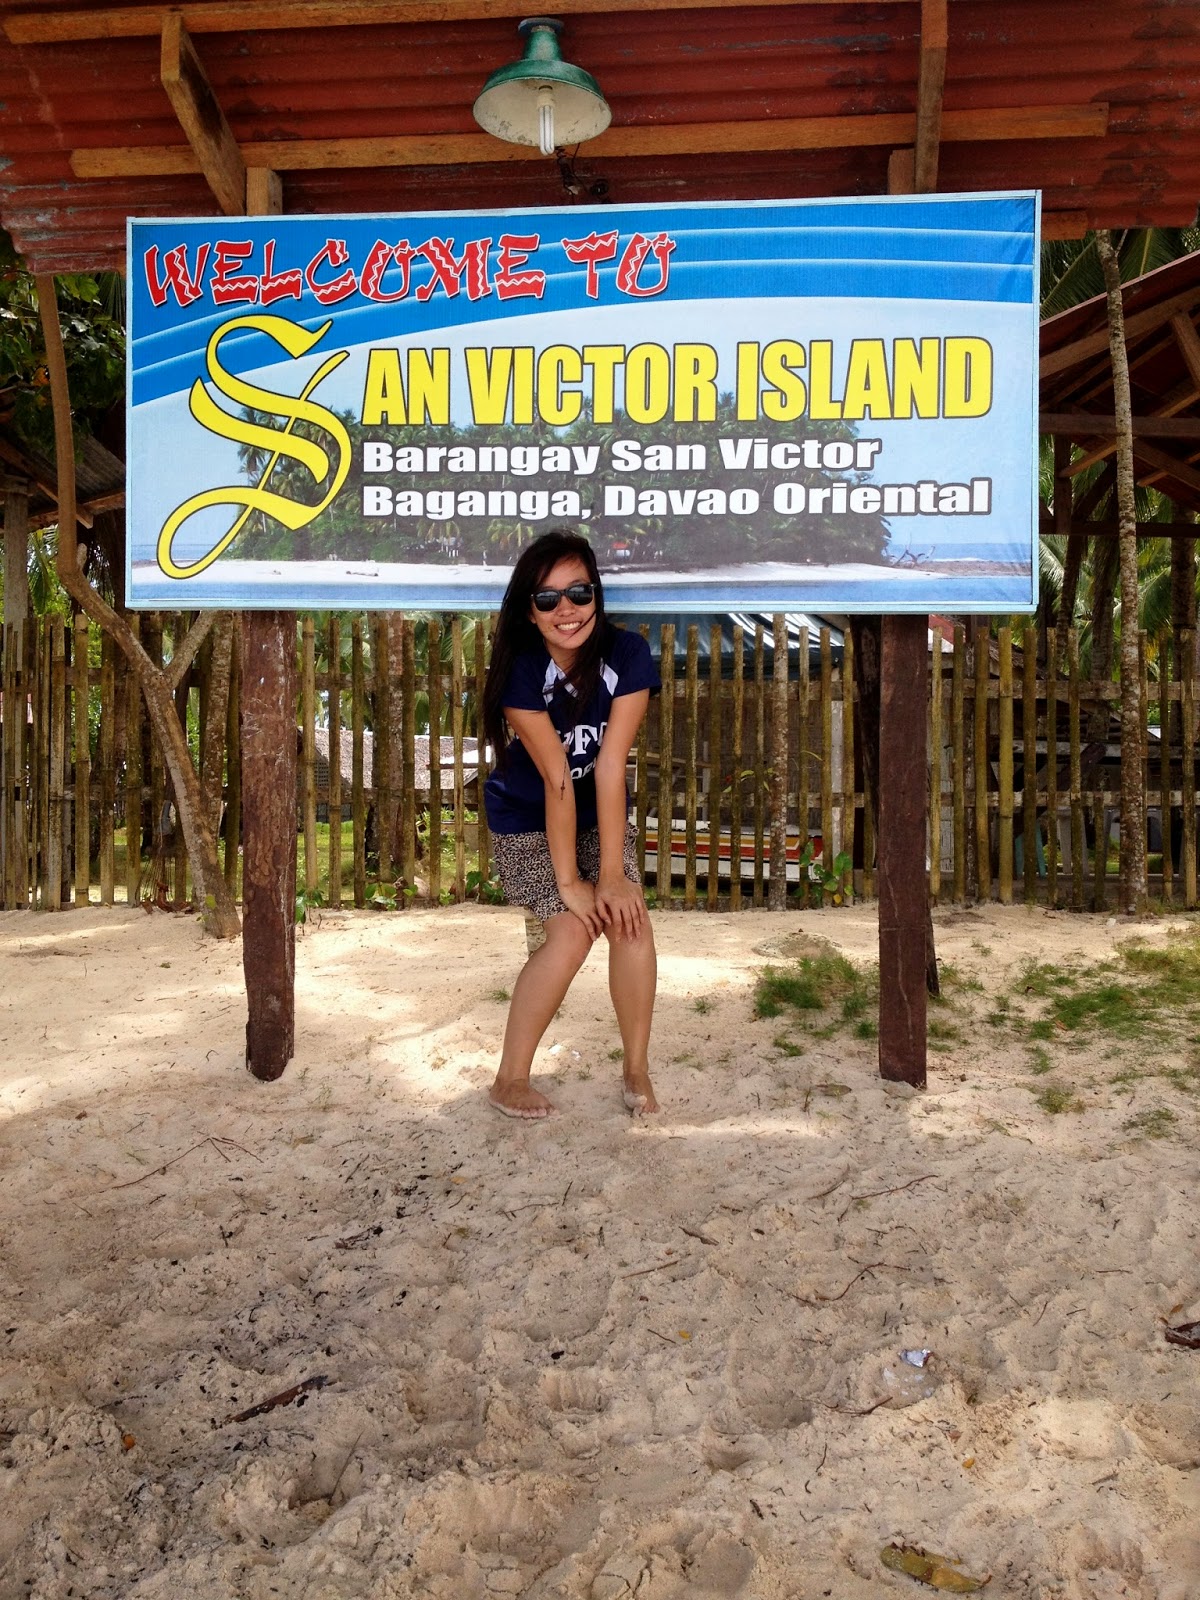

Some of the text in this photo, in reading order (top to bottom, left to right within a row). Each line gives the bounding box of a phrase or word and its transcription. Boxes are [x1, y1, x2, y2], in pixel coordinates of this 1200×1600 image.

[143, 229, 677, 307] WELCOME TO
[465, 341, 719, 427] VICTOR
[736, 336, 994, 422] ISLAND
[362, 437, 881, 477] Barangay San Victor
[362, 478, 992, 521] Baganga, Davao Oriental
